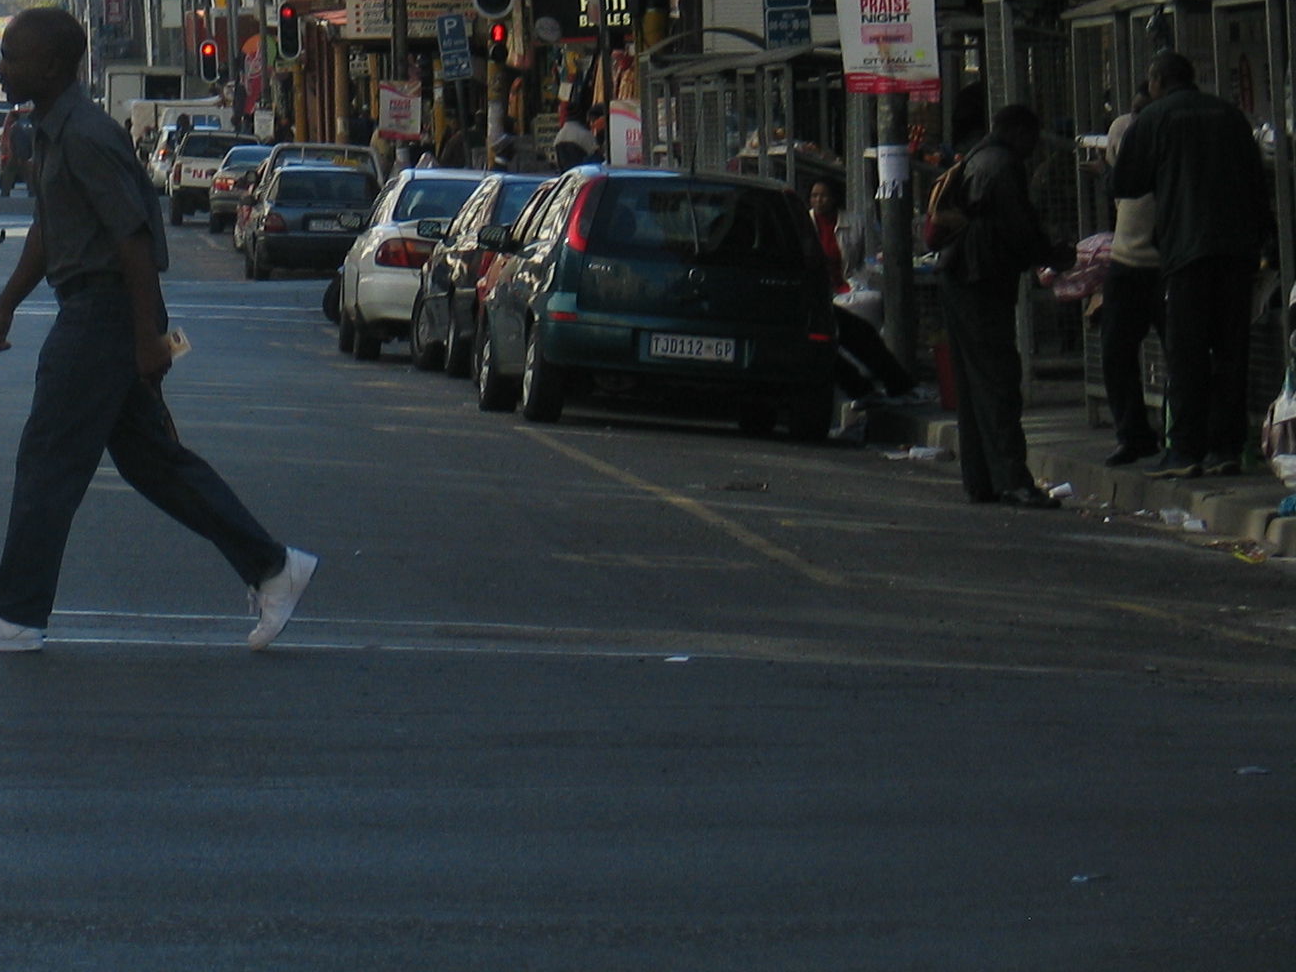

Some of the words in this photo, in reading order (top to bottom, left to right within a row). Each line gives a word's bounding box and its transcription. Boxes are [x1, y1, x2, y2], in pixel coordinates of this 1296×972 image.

[861, 13, 910, 24] NIGHT
[444, 19, 457, 36] P
[653, 336, 704, 356] TJD112
[715, 342, 732, 357] GP
